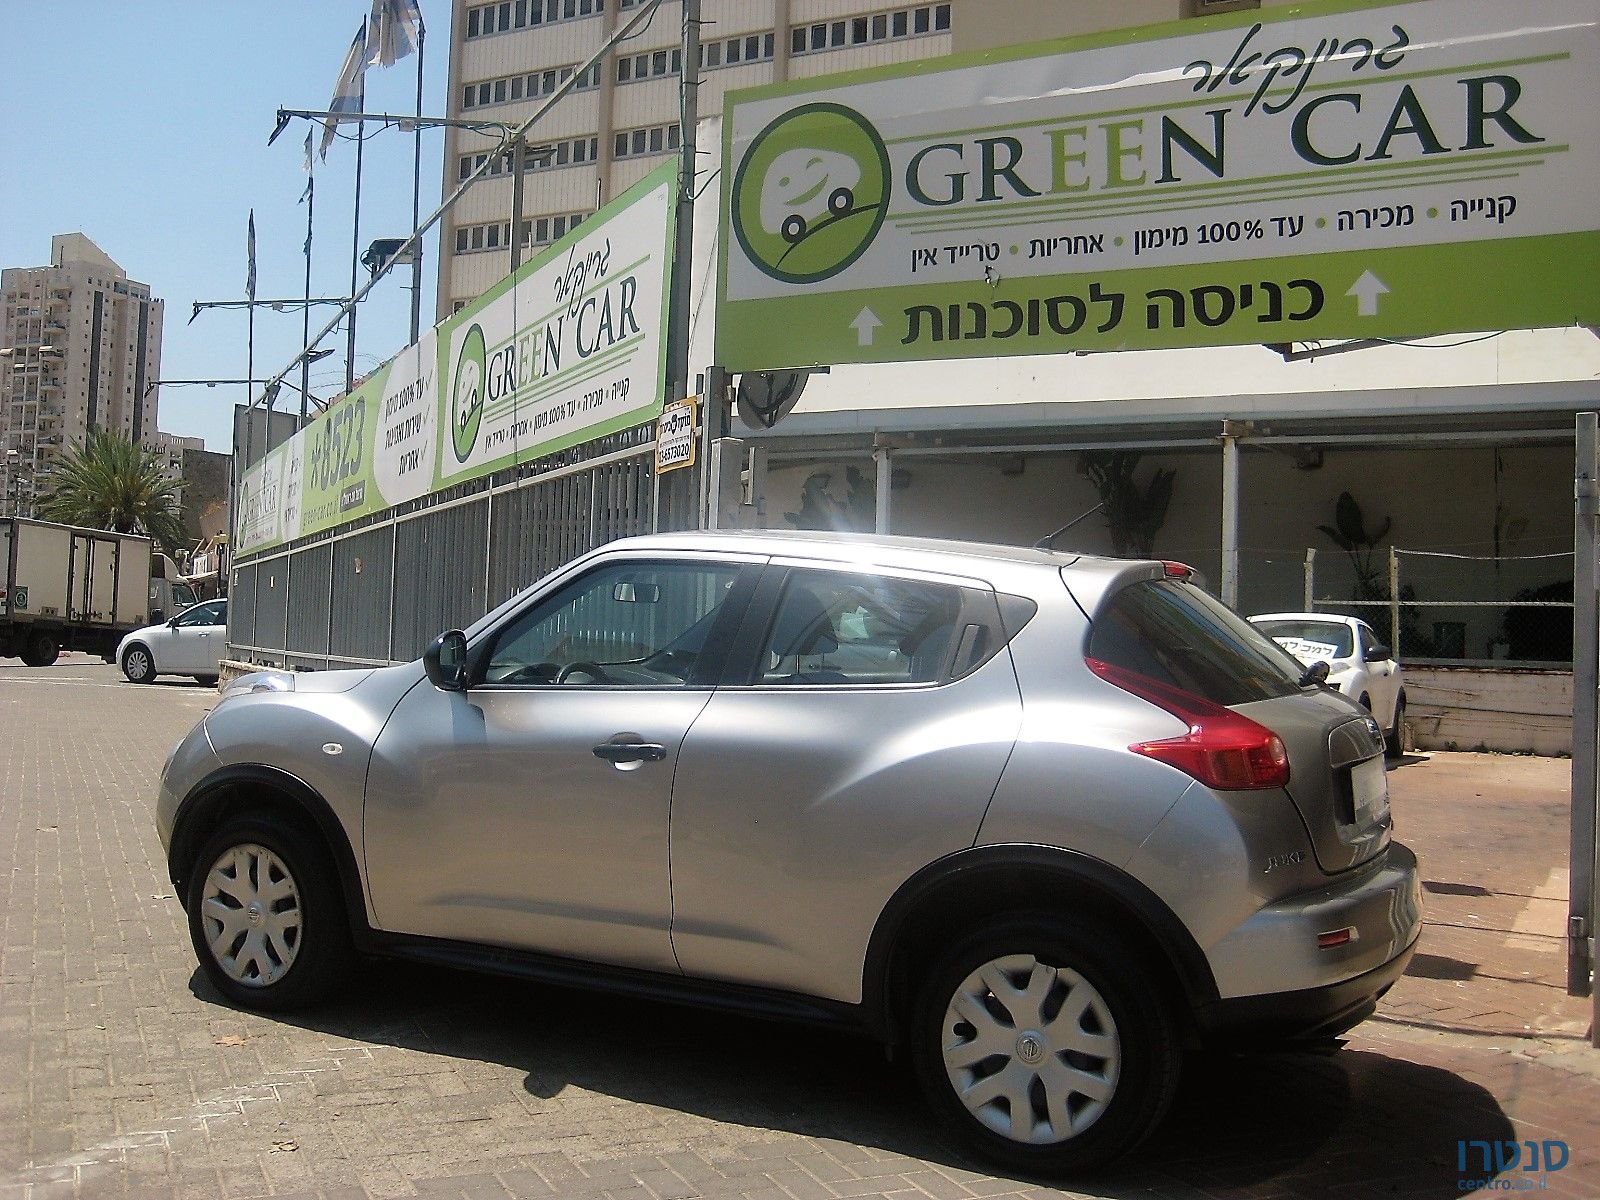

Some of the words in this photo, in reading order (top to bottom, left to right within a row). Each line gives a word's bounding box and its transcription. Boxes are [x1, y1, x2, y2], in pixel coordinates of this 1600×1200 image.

[905, 108, 1232, 206] GREEN
[1291, 74, 1545, 166] CAR
[1338, 204, 1414, 232] מכירה
[1450, 195, 1517, 224] קנייה
[1133, 225, 1189, 255] מימון
[1197, 219, 1264, 244] 100%
[1270, 215, 1304, 237] עד
[911, 248, 938, 272] אין
[943, 242, 1000, 265] טרייד
[1028, 233, 1105, 259] אחריות
[900, 283, 1126, 345] לסוכנות
[1145, 278, 1325, 330] כניסה
[487, 315, 564, 402] GREEN
[576, 275, 641, 359] CAR
